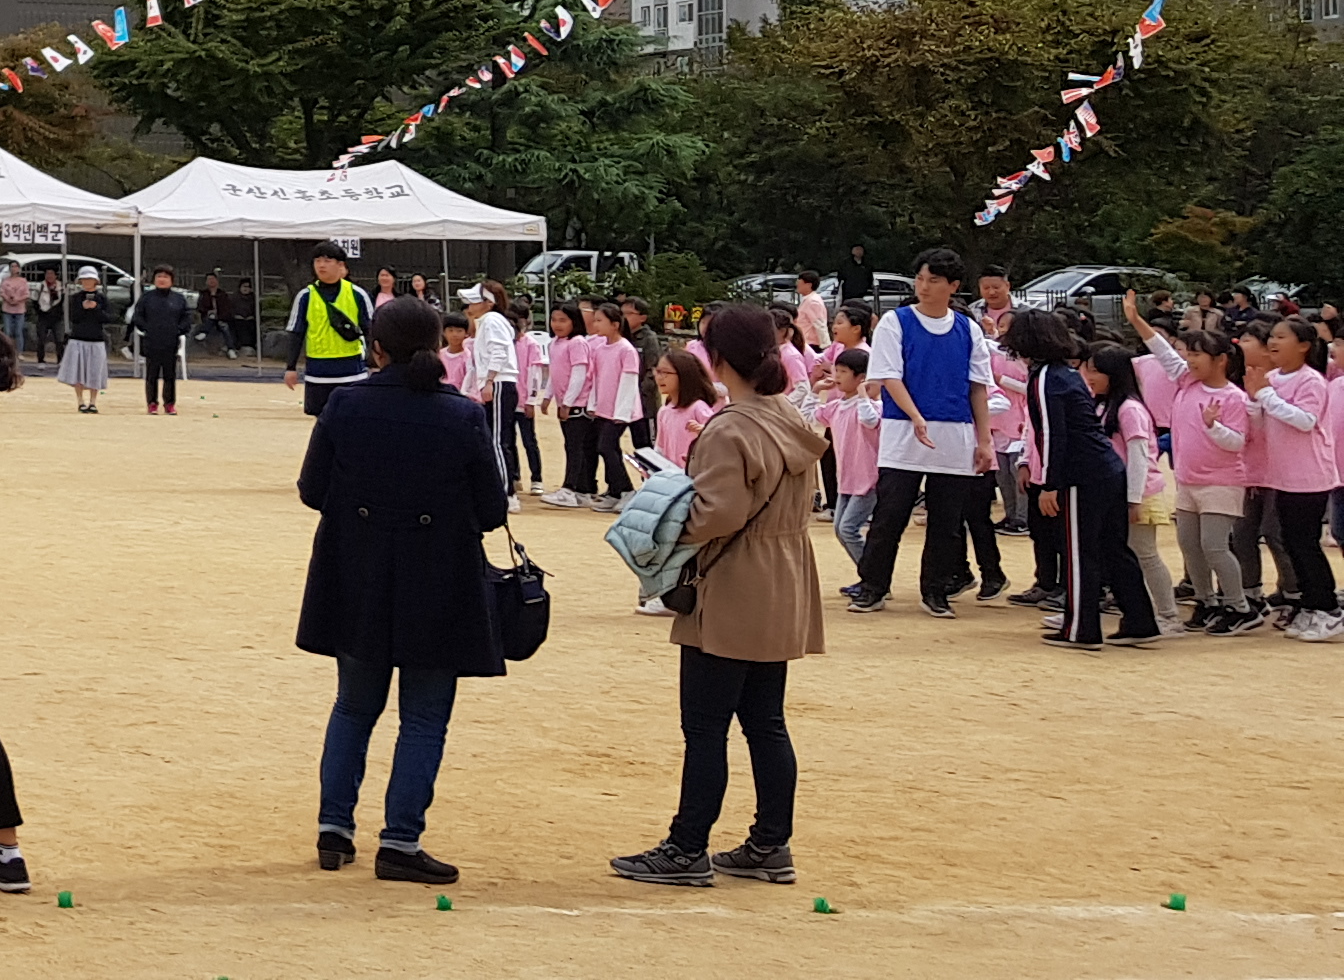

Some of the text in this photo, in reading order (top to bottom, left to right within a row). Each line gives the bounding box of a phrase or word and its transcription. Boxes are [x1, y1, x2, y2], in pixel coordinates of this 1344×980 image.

[222, 183, 410, 202] 군산신흥초등학교
[3, 223, 63, 242] 3학년 백군
